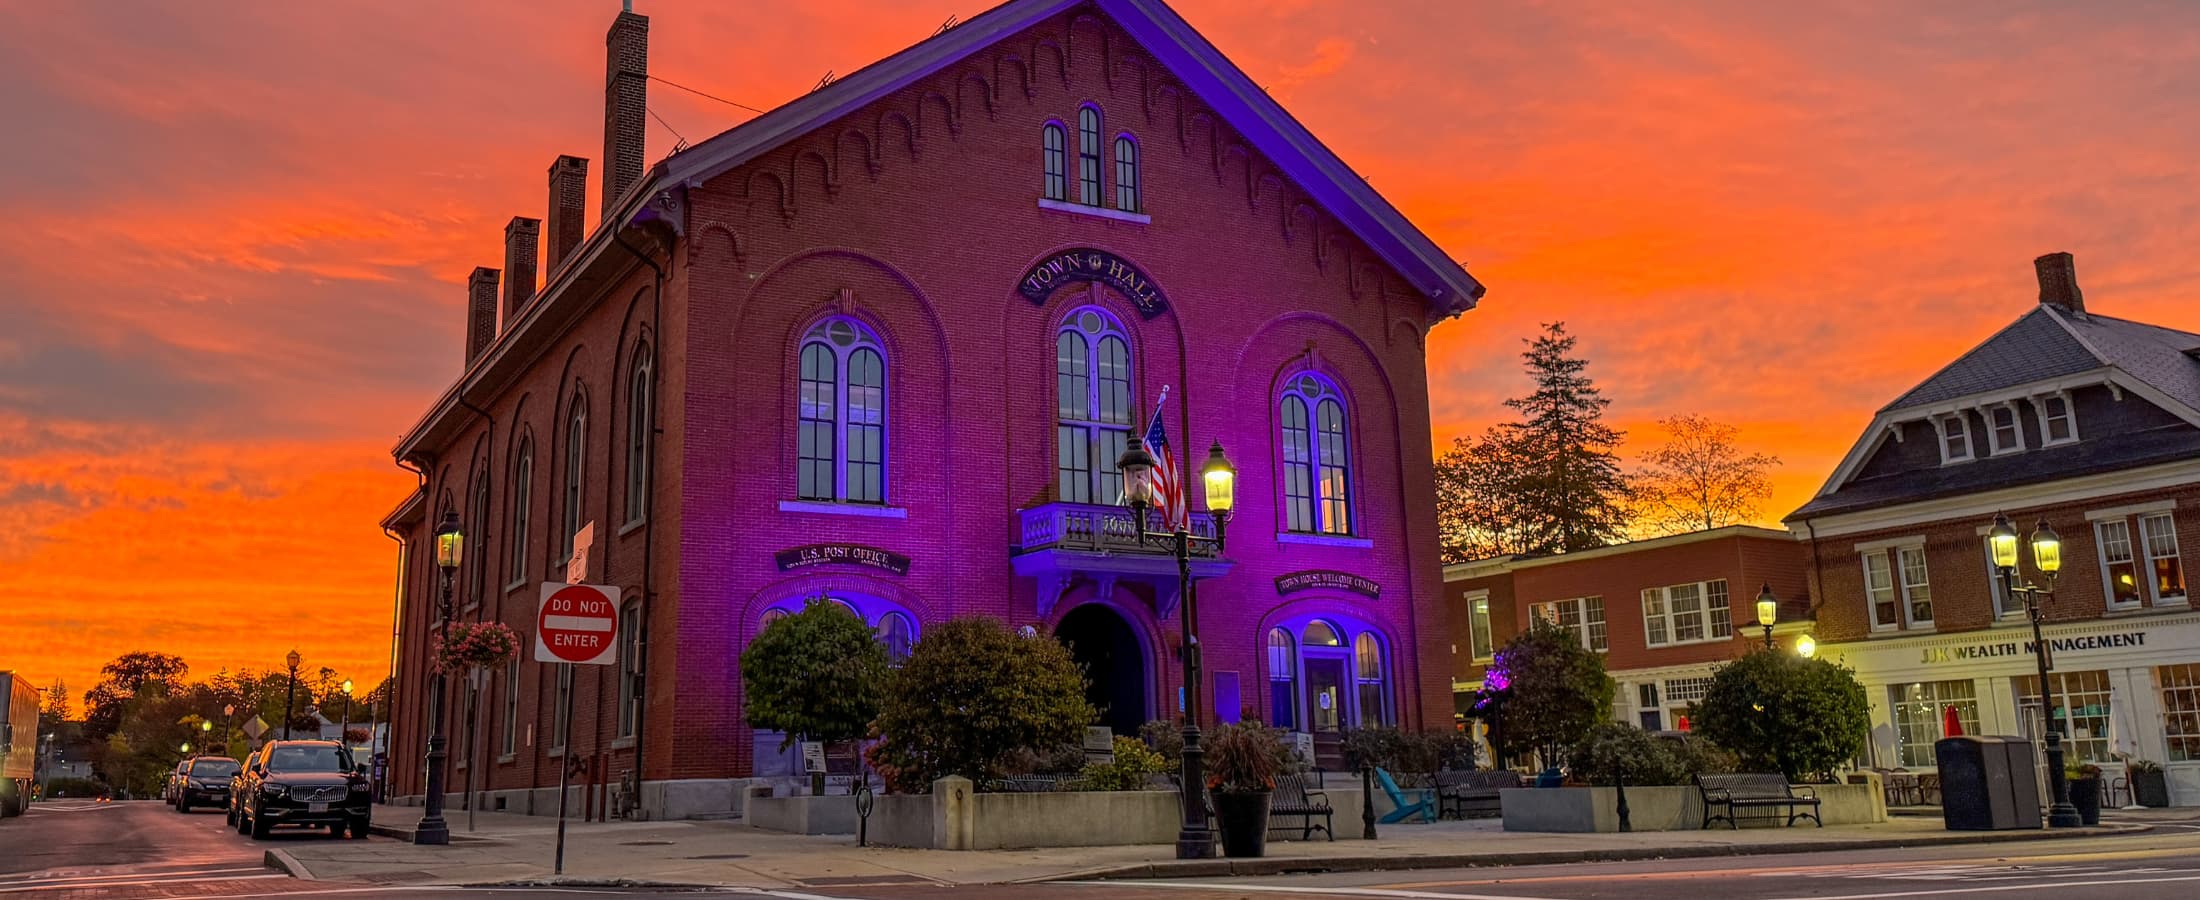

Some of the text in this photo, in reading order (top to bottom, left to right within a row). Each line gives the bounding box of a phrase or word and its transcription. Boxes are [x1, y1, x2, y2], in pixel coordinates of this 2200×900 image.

[1026, 253, 1081, 290] TOWN
[1108, 259, 1157, 308] HALL
[800, 547, 889, 563] U.S. POST OFFICE
[1281, 577, 1299, 589] TOWN
[1300, 573, 1320, 584] HOUSE
[1322, 573, 1353, 585] WELCOME
[1354, 578, 1379, 593] CENTER
[552, 599, 607, 614] DO NOT
[554, 633, 599, 648] ENTER
[1920, 632, 2146, 664] JJK WEALTH MNAGEMENT
